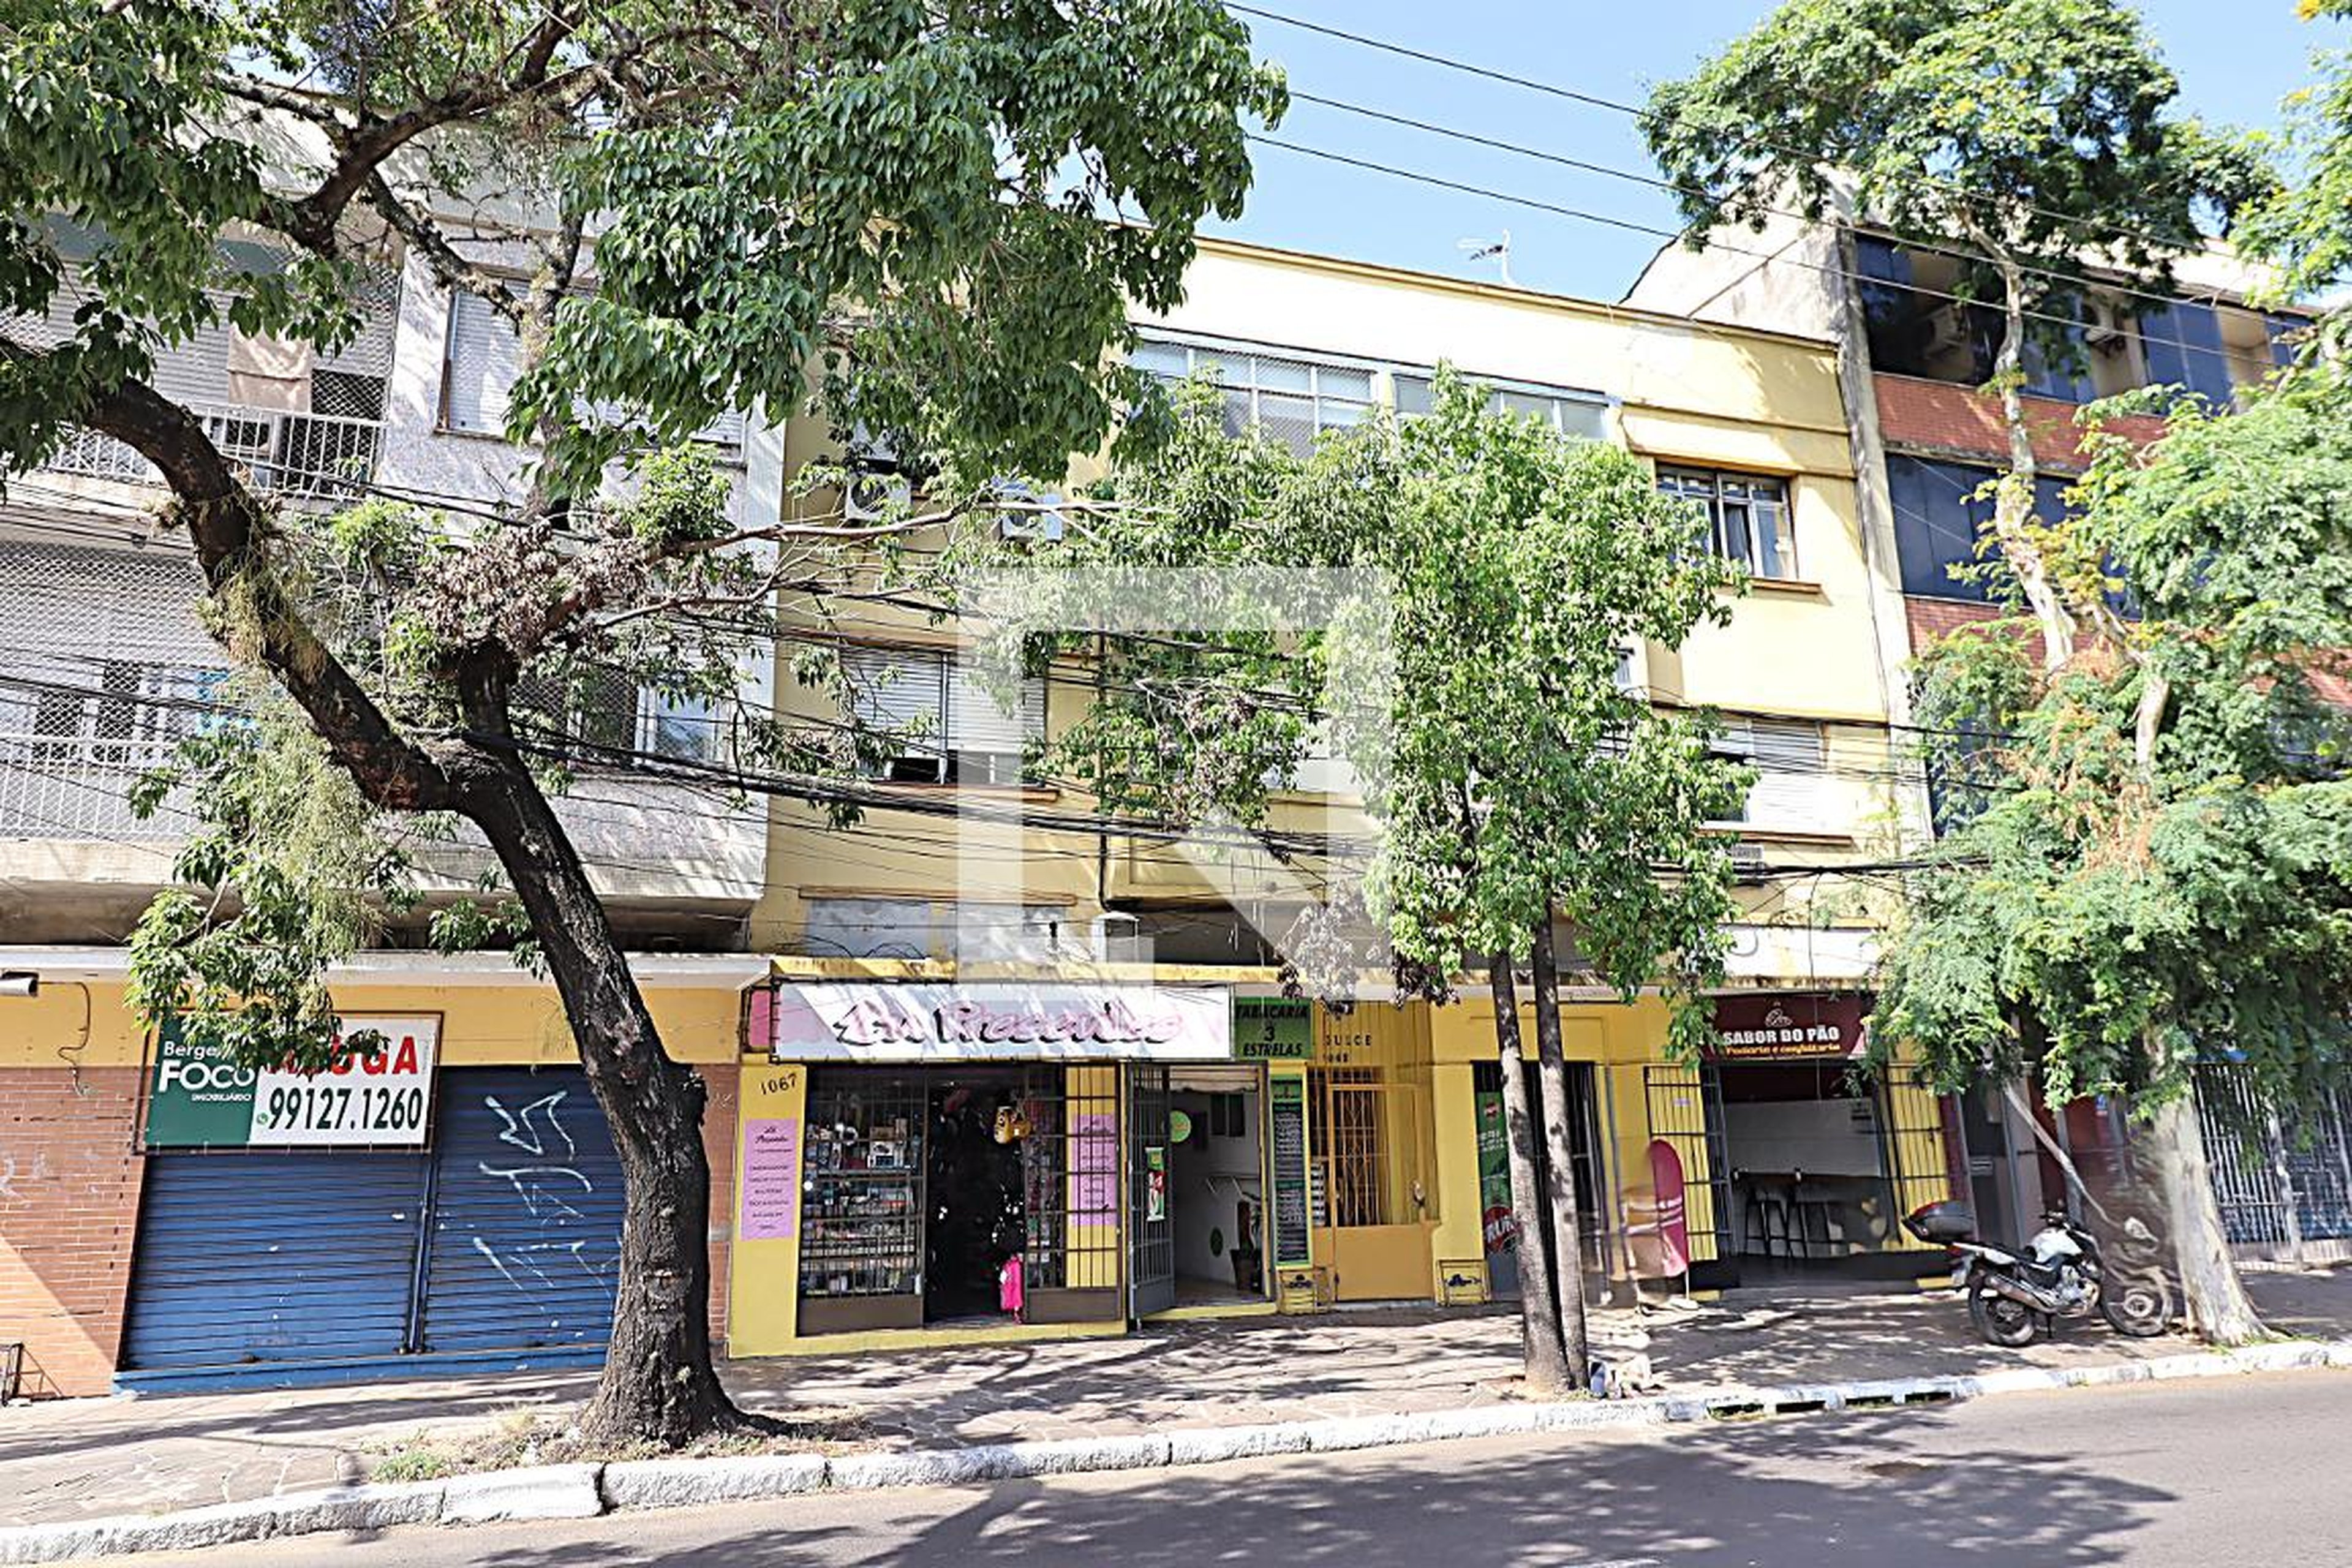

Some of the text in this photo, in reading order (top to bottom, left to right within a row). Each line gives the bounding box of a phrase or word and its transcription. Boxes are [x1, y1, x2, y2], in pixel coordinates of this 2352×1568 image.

[1236, 1004, 1308, 1019] TABACARIA
[1264, 1026, 1275, 1041] 3
[1723, 1025, 1840, 1045] SABOR DO PÃO
[1243, 1042, 1302, 1057] ESTRELAS
[760, 1072, 797, 1095] 1067
[268, 1087, 423, 1130] 99127.1260
